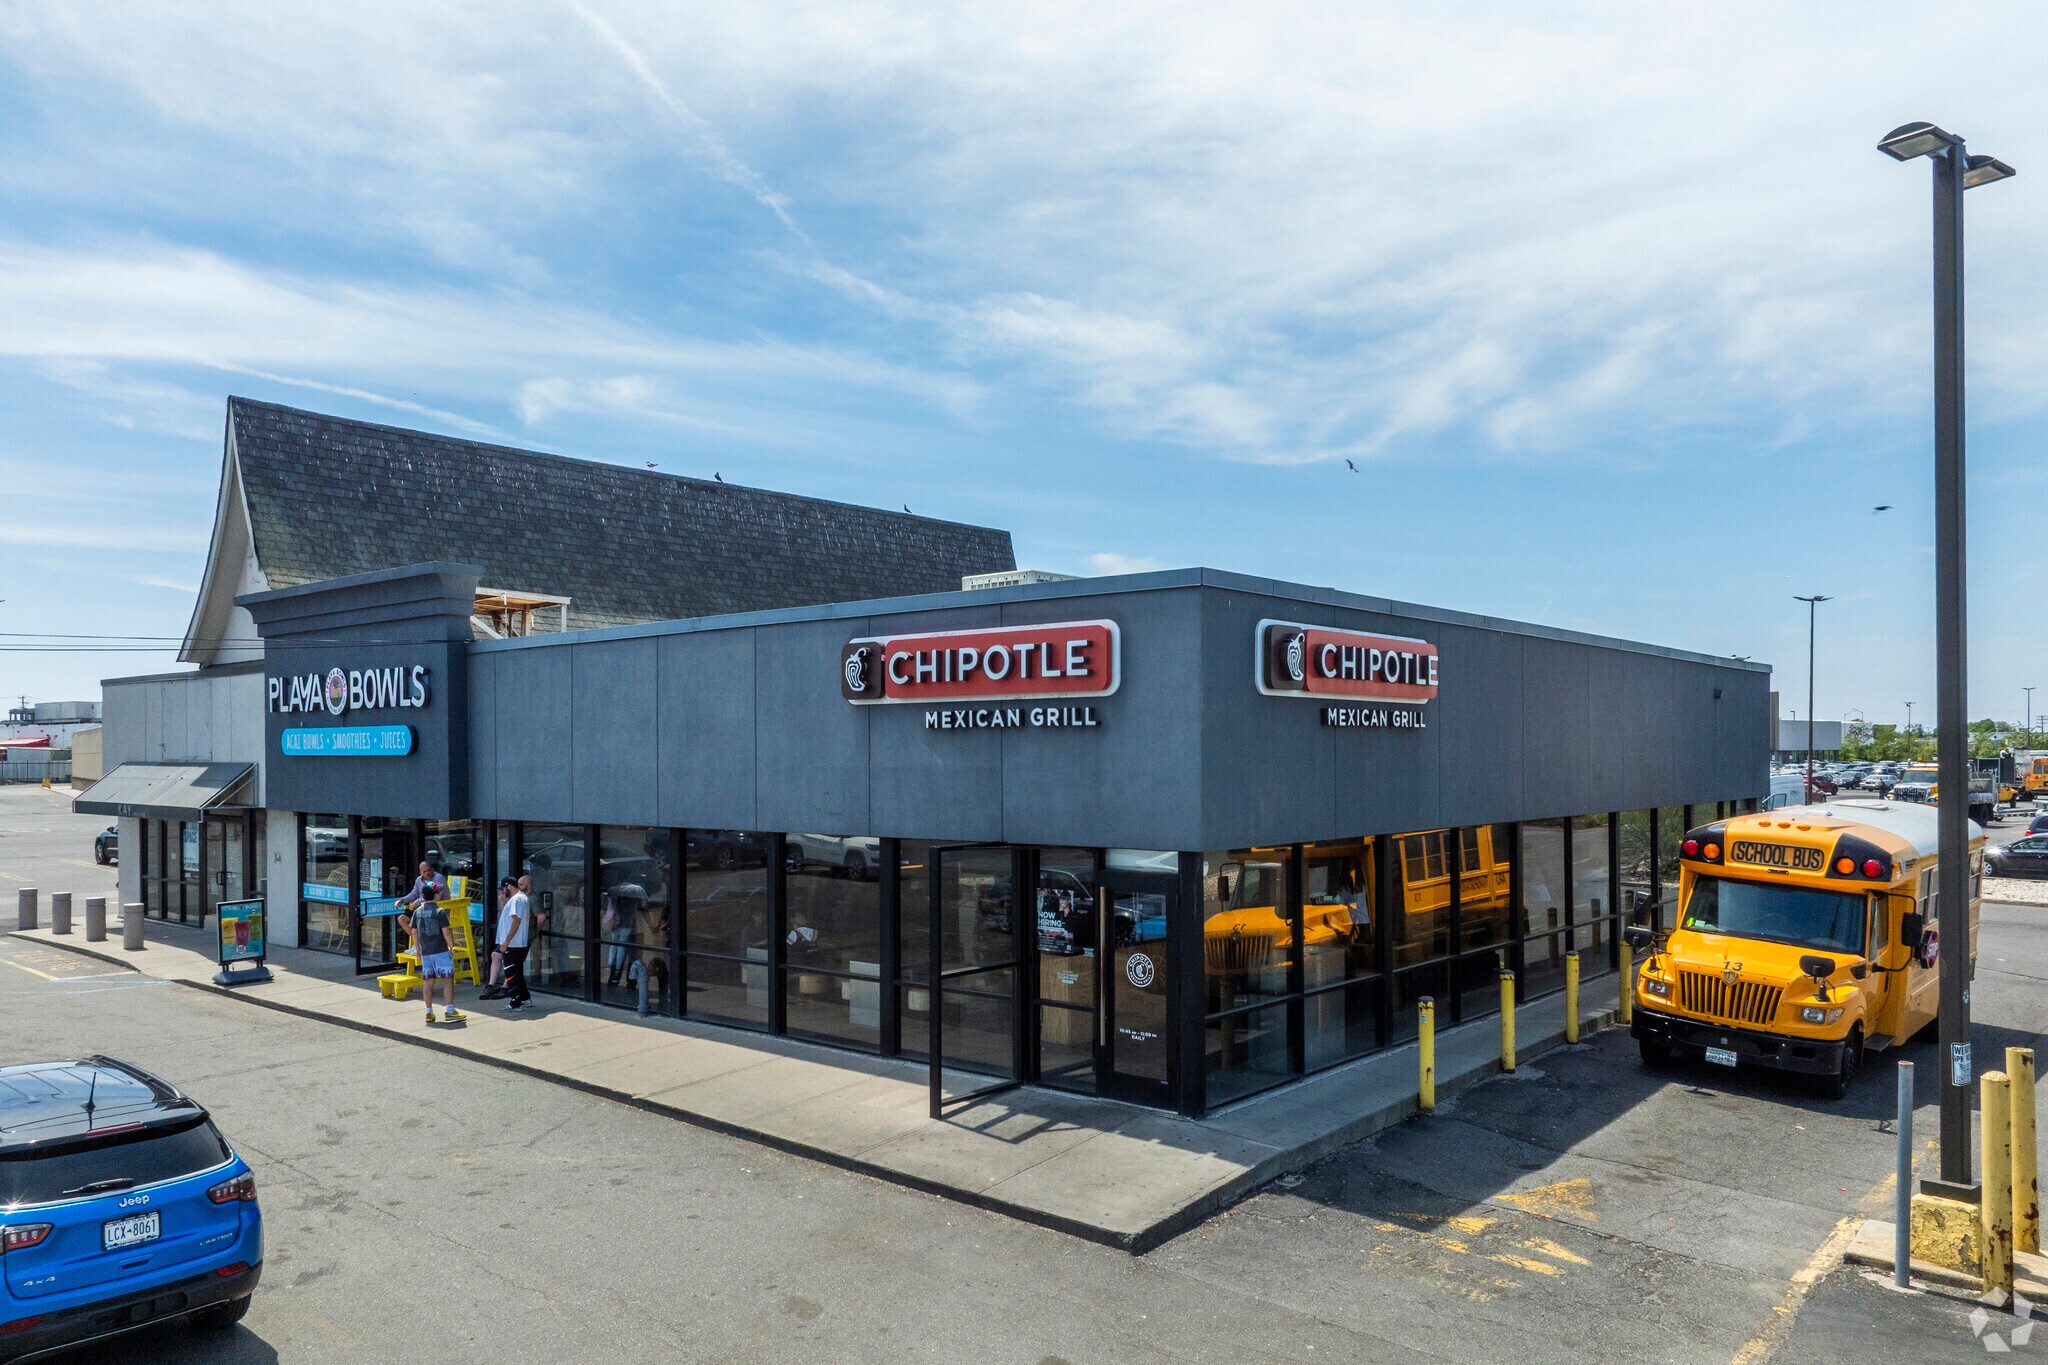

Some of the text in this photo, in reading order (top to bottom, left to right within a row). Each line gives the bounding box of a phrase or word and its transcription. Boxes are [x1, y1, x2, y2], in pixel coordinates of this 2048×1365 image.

[888, 639, 1089, 685] CHIPOTLE
[1321, 643, 1439, 686] CHIPOTLE
[269, 664, 426, 712] PLAYA BOWLS
[925, 707, 1096, 729] MEXICAN GRILL
[1327, 708, 1426, 728] MEXICAN GRILL
[303, 733, 325, 749] BOWLS
[332, 732, 371, 749] SMOOTHIES
[380, 731, 406, 749] JUICES
[1736, 842, 1820, 869] SCHOOL BUS
[1039, 912, 1056, 920] NOW
[1039, 919, 1062, 928] HIRING
[1723, 961, 1743, 972] 13
[119, 1195, 150, 1208] Jeep
[23, 1276, 56, 1287] 4x4
